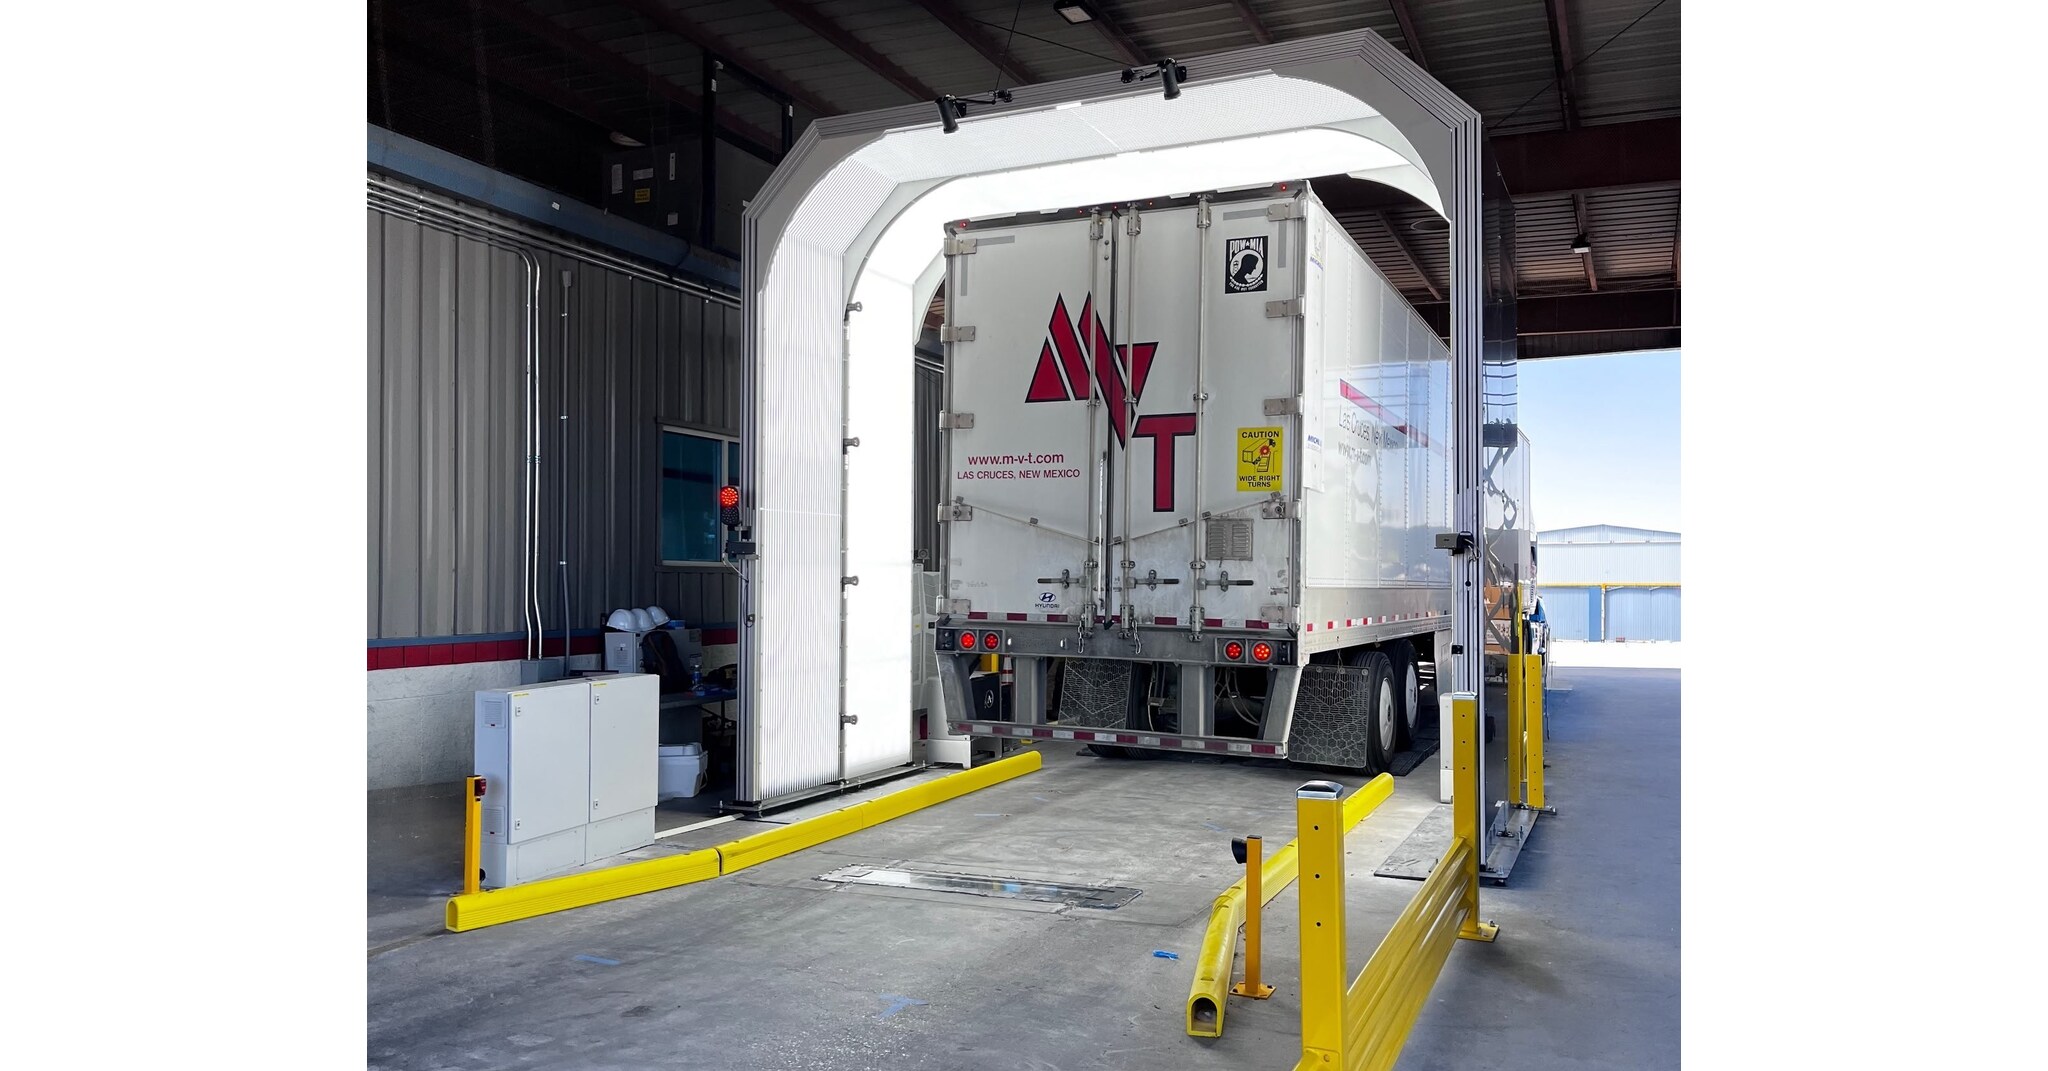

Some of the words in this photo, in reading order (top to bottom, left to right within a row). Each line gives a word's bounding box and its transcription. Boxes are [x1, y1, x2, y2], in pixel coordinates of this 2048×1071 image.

[967, 452, 1064, 465] www.m-v-t.com
[957, 471, 975, 480] LAS
[976, 470, 1016, 481] CRUCES,
[1019, 470, 1041, 479] NEW
[1043, 469, 1081, 478] MEXICO
